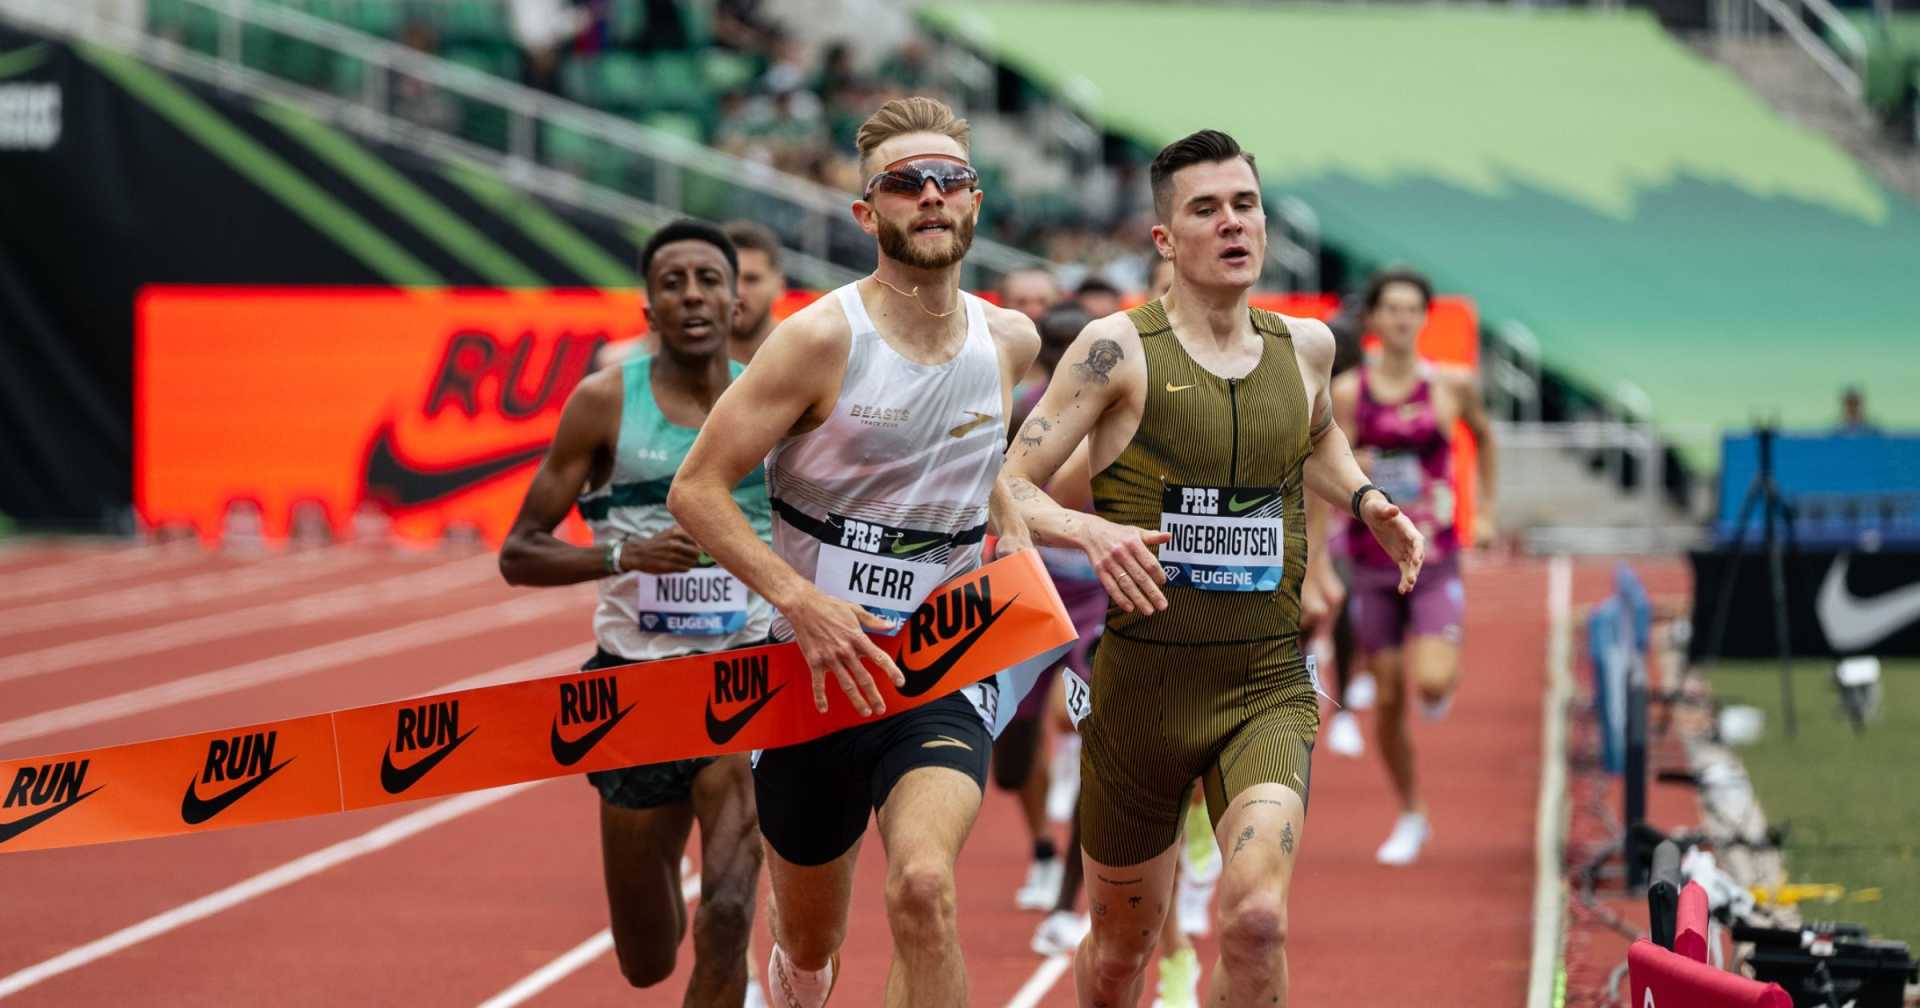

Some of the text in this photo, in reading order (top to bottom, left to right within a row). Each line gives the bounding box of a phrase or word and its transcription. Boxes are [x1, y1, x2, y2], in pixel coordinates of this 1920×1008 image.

[850, 403, 912, 421] BEASTS
[1181, 487, 1219, 515] PRE
[840, 519, 884, 554] PRE
[1165, 522, 1277, 556] INGEBRIGTSEN
[655, 576, 733, 604] NUGUSE
[848, 561, 915, 601] KERR
[1191, 569, 1253, 585] EUGENE
[666, 616, 723, 631] EUGENE
[910, 575, 993, 655] RUN
[714, 655, 769, 705] RUN
[1068, 678, 1086, 716] 15
[560, 676, 619, 726] RUN
[395, 700, 459, 753] RUN
[202, 731, 278, 785] RUN
[2, 759, 91, 809] RUN
